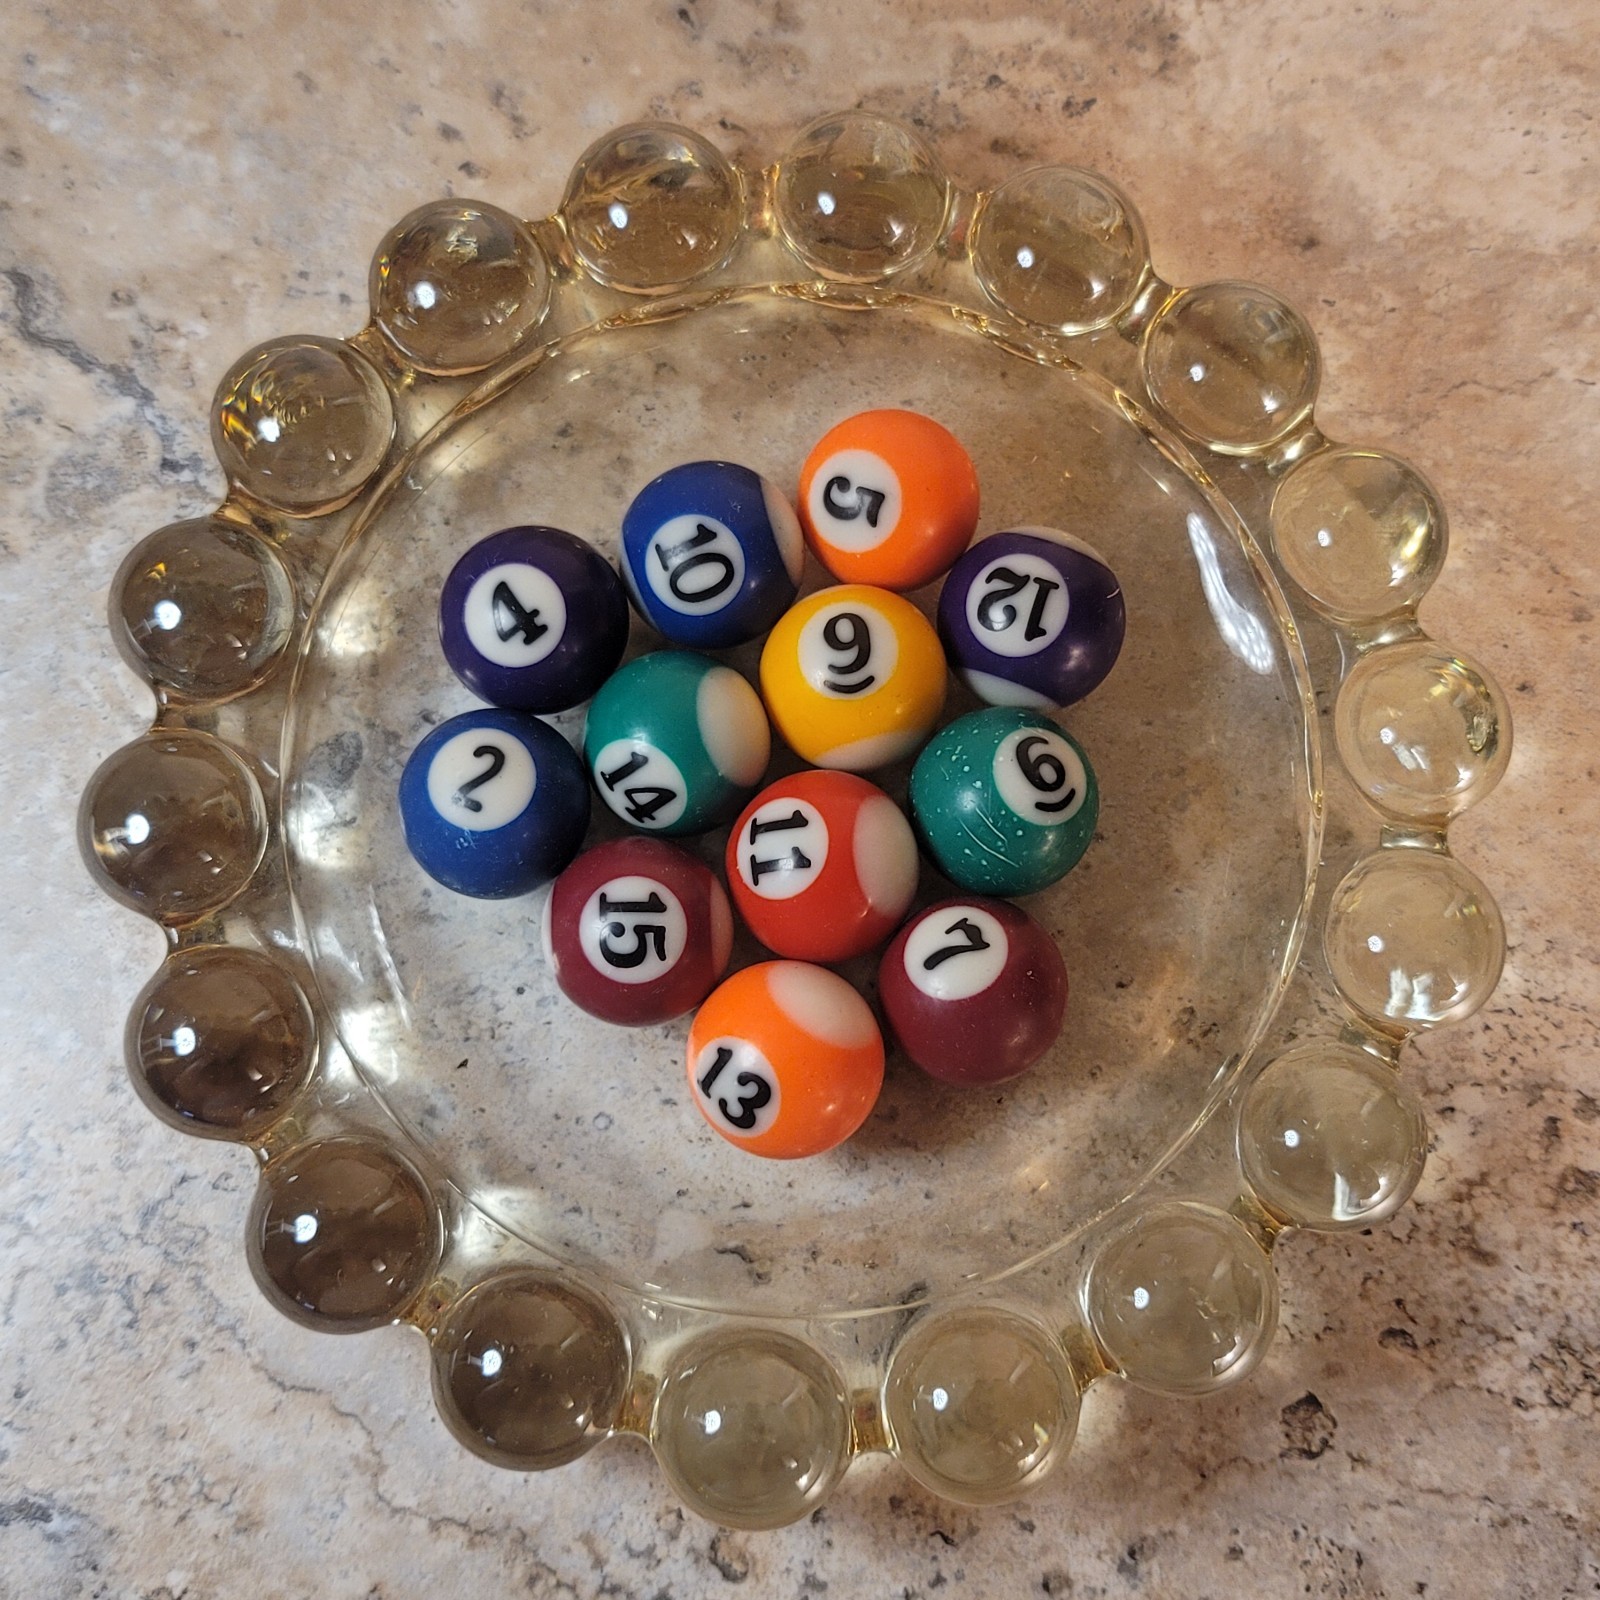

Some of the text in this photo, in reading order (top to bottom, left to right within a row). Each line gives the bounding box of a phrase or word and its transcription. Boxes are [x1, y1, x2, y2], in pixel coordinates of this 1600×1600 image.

[823, 476, 886, 528] 5
[655, 523, 736, 604] 10
[492, 581, 549, 645] 4
[976, 567, 1061, 642] 12
[823, 613, 872, 676] 9
[453, 745, 505, 813] 2
[600, 752, 678, 824] 14
[1015, 736, 1067, 794] 6
[749, 810, 812, 887] 11
[599, 891, 667, 969] 15
[923, 918, 991, 971] 7
[697, 1047, 772, 1130] 13
